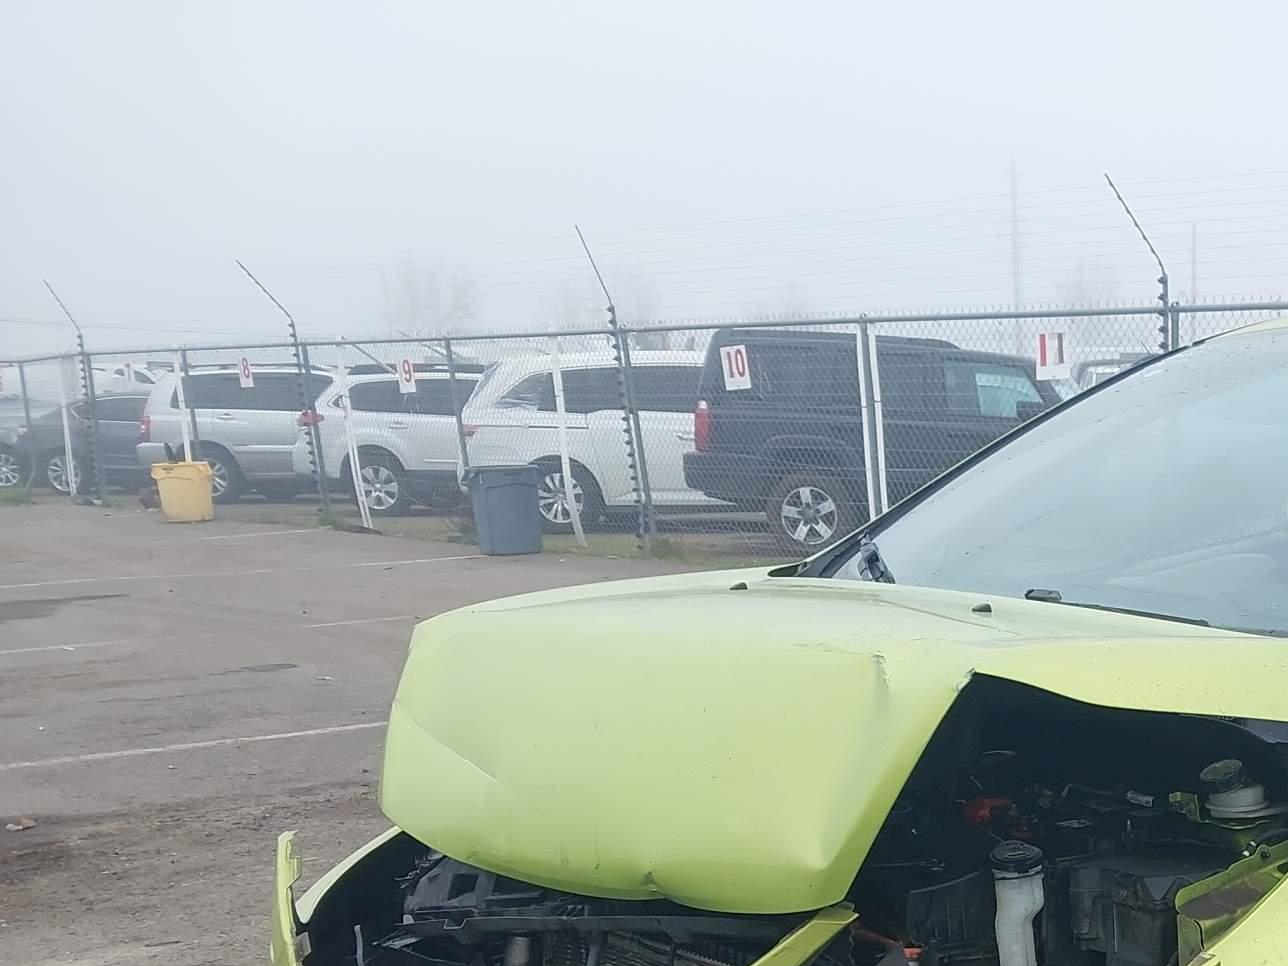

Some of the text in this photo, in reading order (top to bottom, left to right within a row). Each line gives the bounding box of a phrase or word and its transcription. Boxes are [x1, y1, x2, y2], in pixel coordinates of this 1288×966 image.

[241, 357, 250, 378] 8
[402, 359, 412, 383] 9
[727, 348, 746, 378] 10
